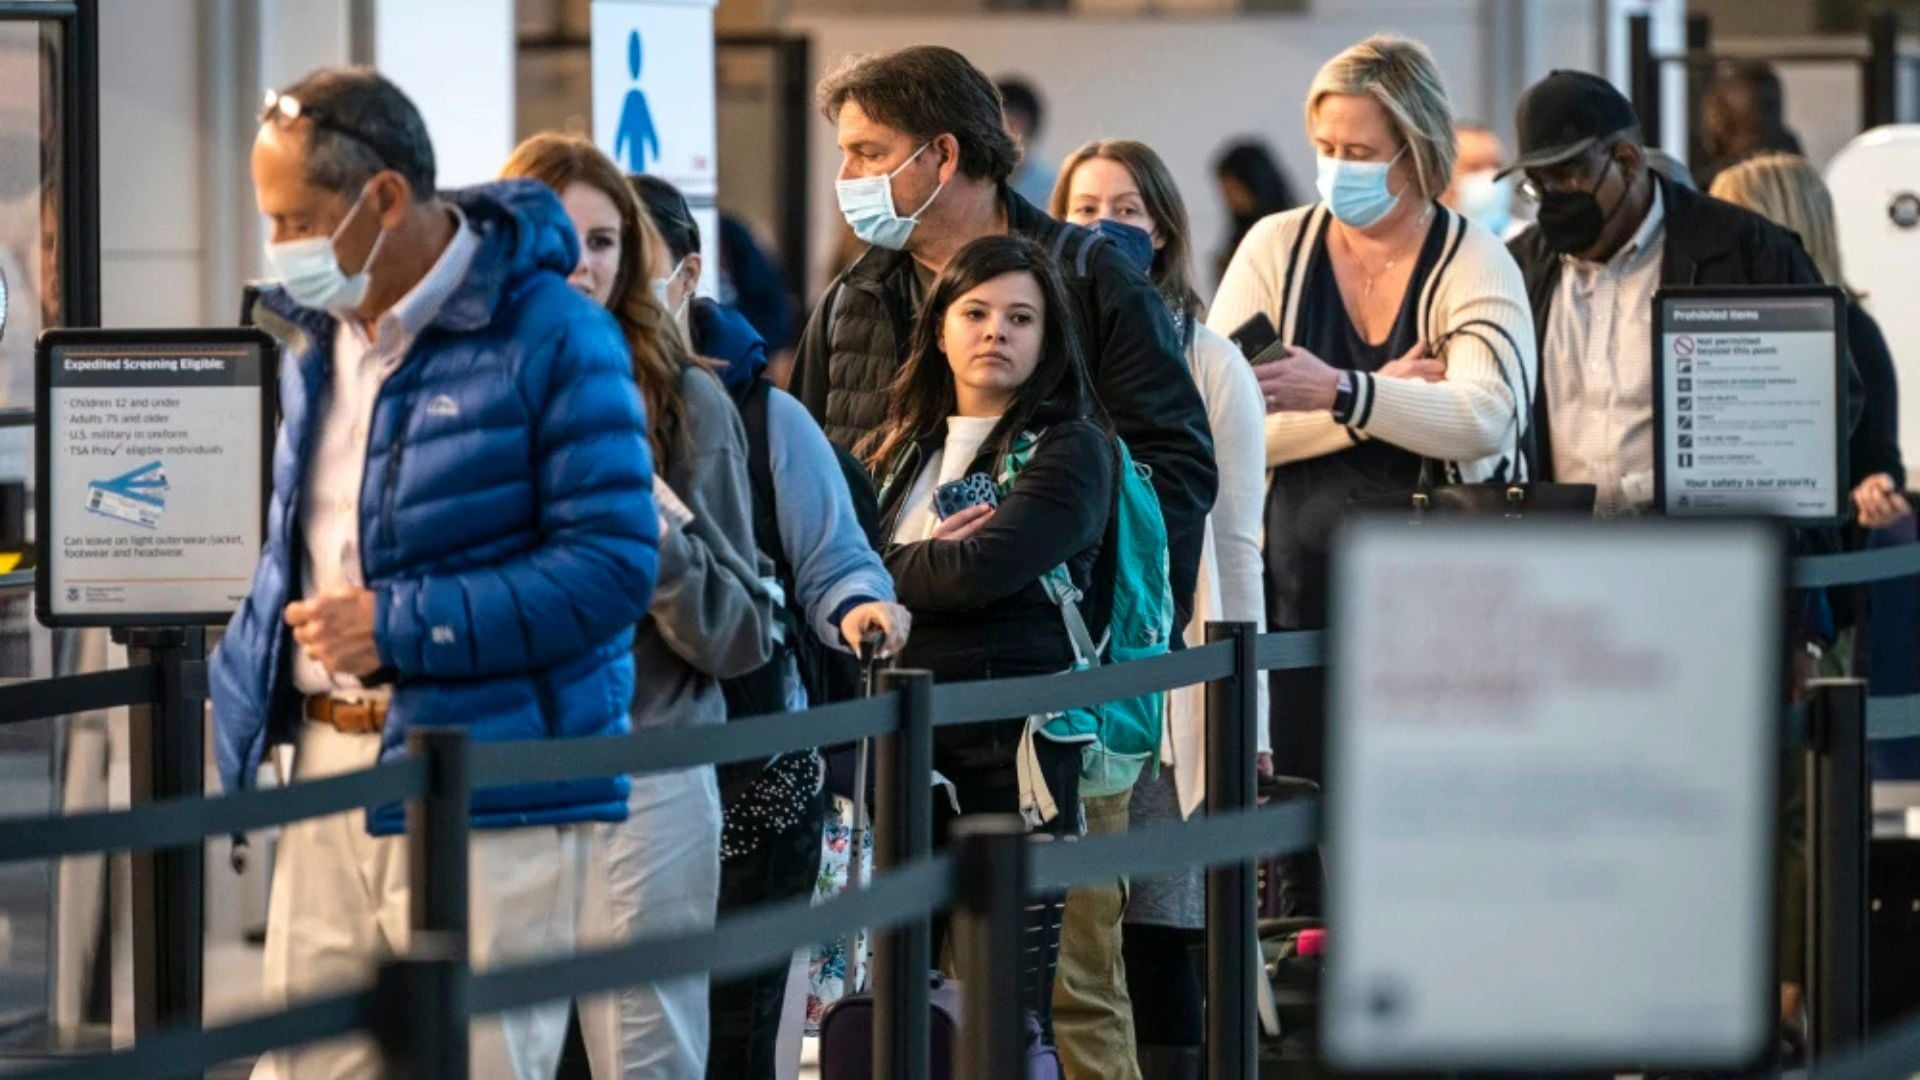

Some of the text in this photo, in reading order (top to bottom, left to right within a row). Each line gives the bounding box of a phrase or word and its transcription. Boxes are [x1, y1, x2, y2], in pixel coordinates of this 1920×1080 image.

[64, 358, 225, 371] Expedited Screening Eligible:
[69, 398, 180, 408] Children 12 and under
[69, 414, 169, 424] Adults 75 and older
[91, 430, 131, 442] military
[134, 430, 144, 440] in
[147, 430, 189, 440] uniform
[70, 446, 89, 456] TSA
[126, 445, 166, 457] eligible
[168, 445, 223, 455] individuals
[1685, 477, 1707, 487] Your
[1711, 477, 1742, 489] safety
[1757, 478, 1773, 487] our
[1777, 477, 1817, 489] priority
[64, 537, 83, 546] Can
[86, 537, 112, 546] leave
[115, 538, 128, 546] on
[131, 536, 153, 549] light
[64, 549, 109, 559] footwear
[112, 549, 131, 558] and
